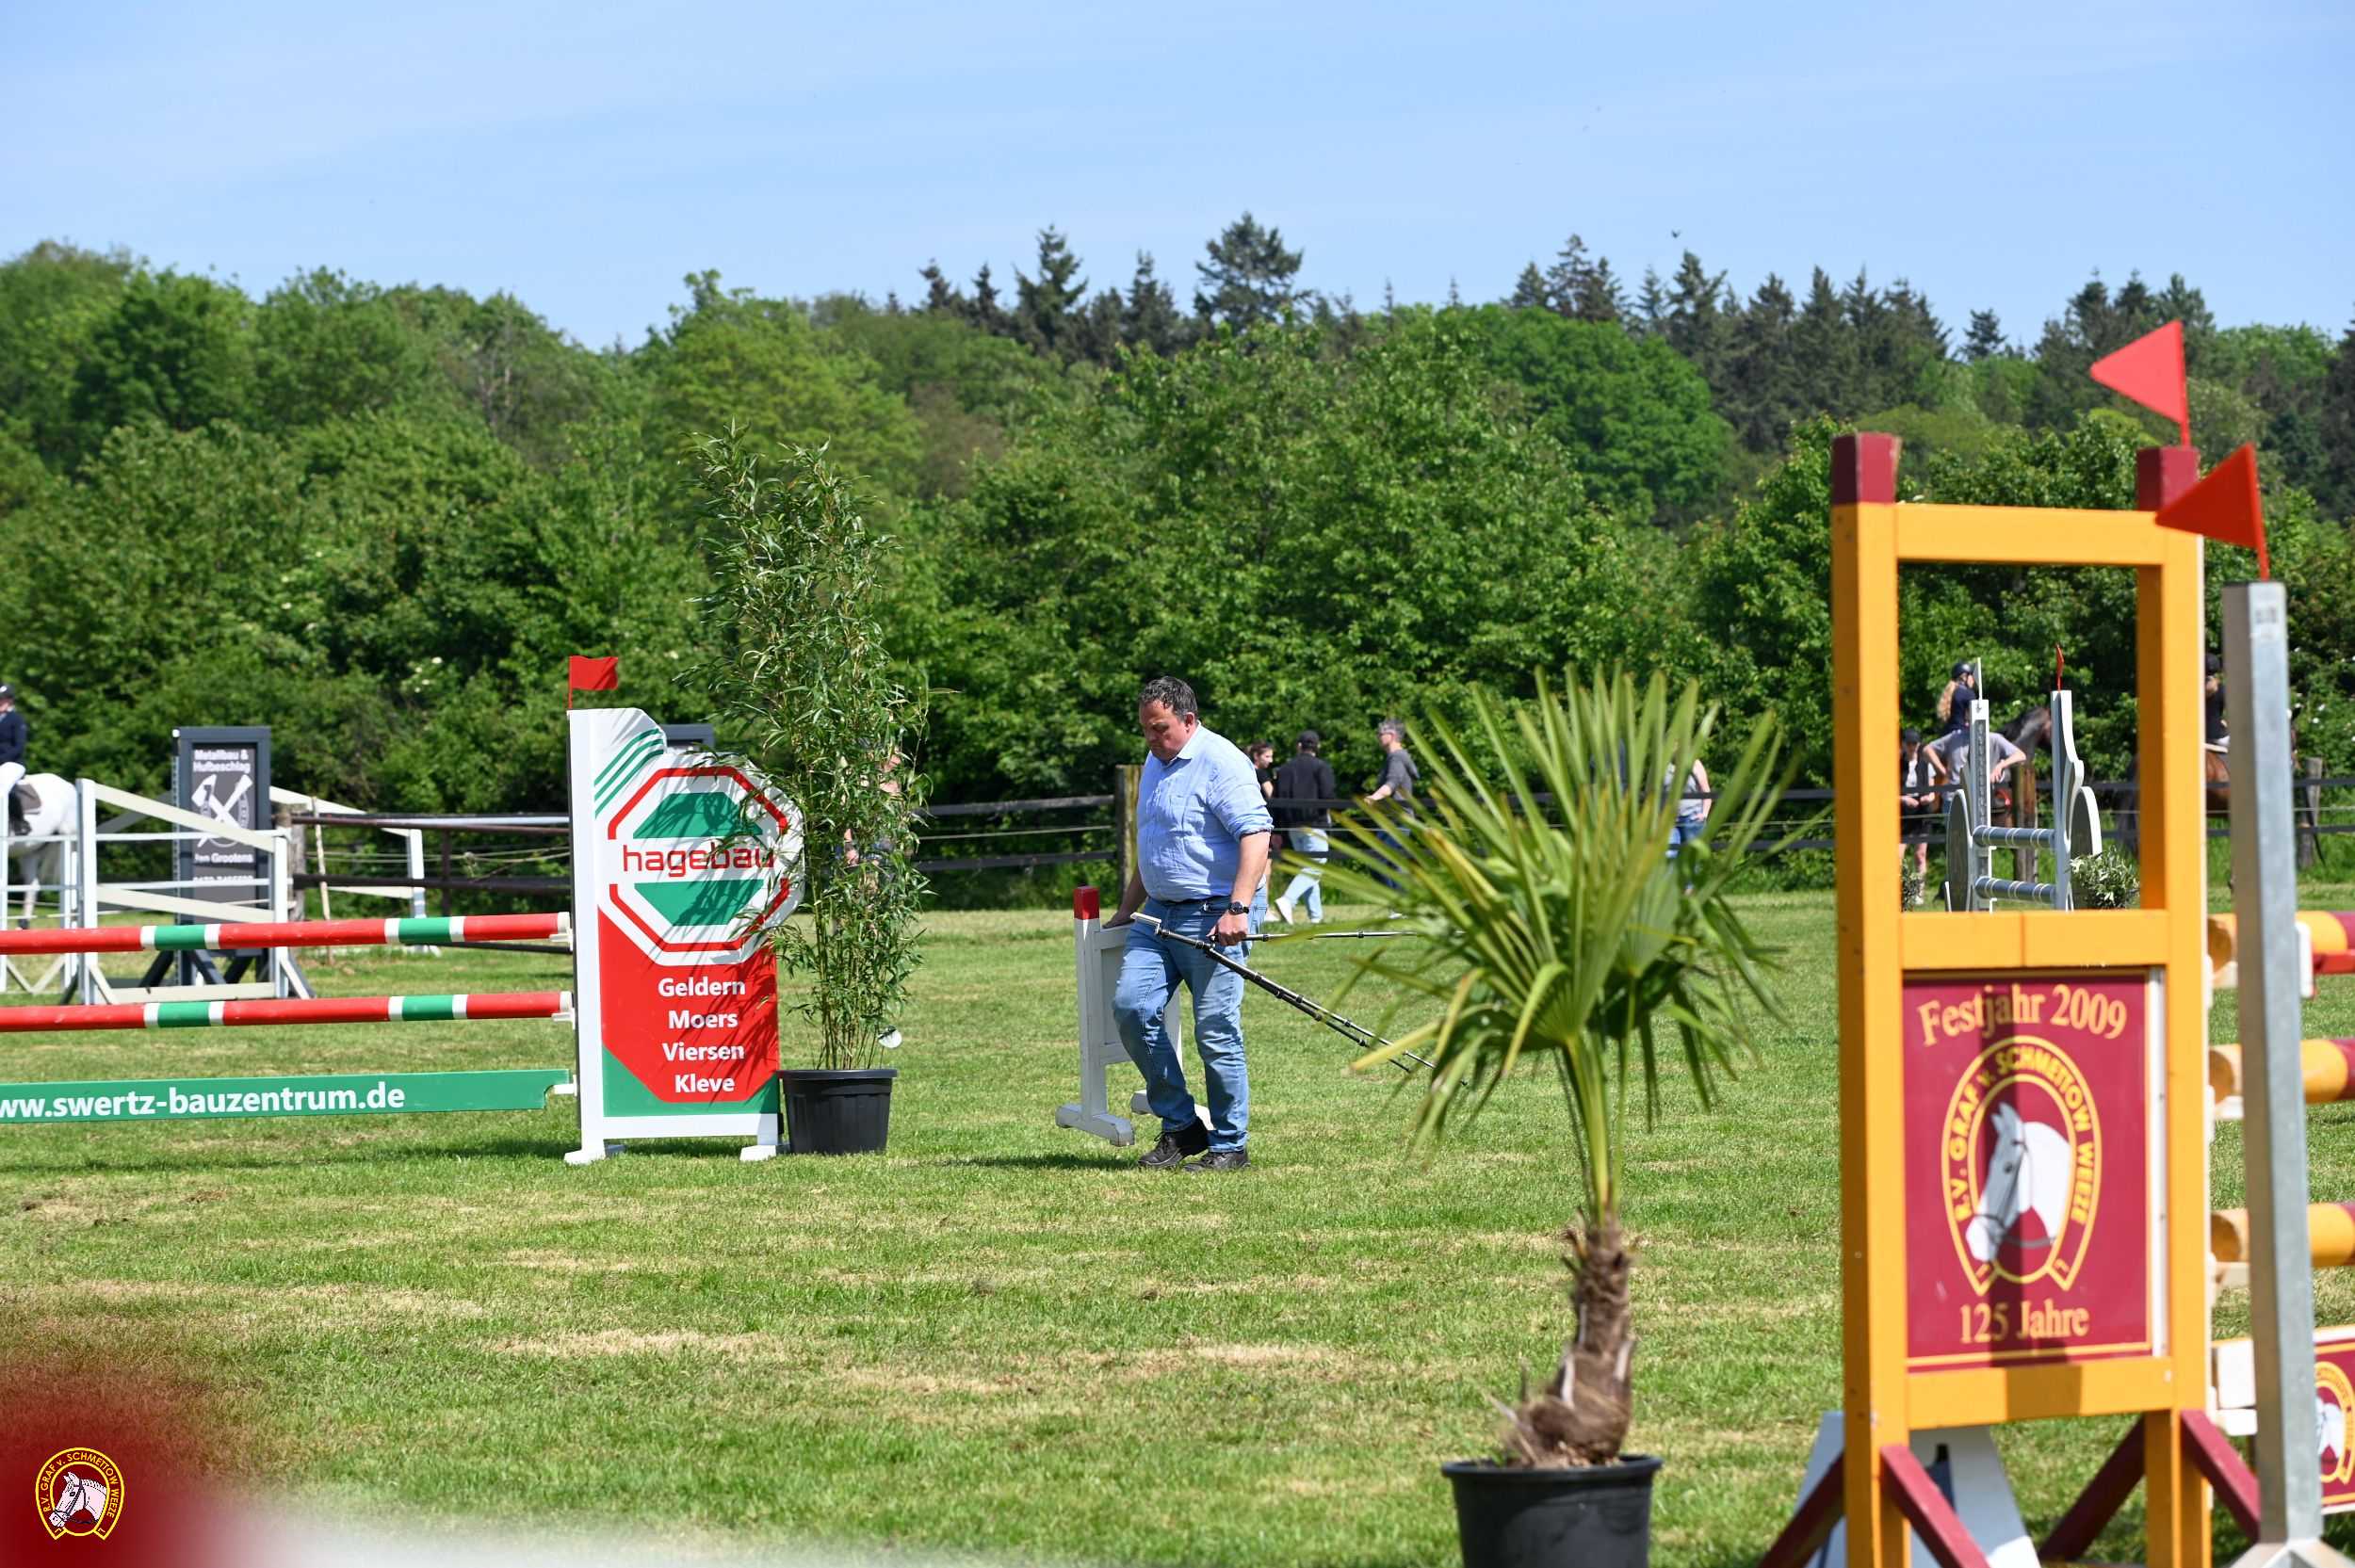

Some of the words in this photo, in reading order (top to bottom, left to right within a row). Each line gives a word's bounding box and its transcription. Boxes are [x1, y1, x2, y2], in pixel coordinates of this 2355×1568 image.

[623, 842, 774, 877] hagebau
[658, 977, 746, 996] Geldern
[668, 1010, 739, 1029] Moers
[1917, 983, 2046, 1046] Festjahr
[2050, 983, 2127, 1039] 2009
[662, 1042, 745, 1061] Viersen
[674, 1074, 735, 1093] Kleve
[1959, 1302, 2009, 1344] 125
[2015, 1298, 2089, 1339] Jahre
